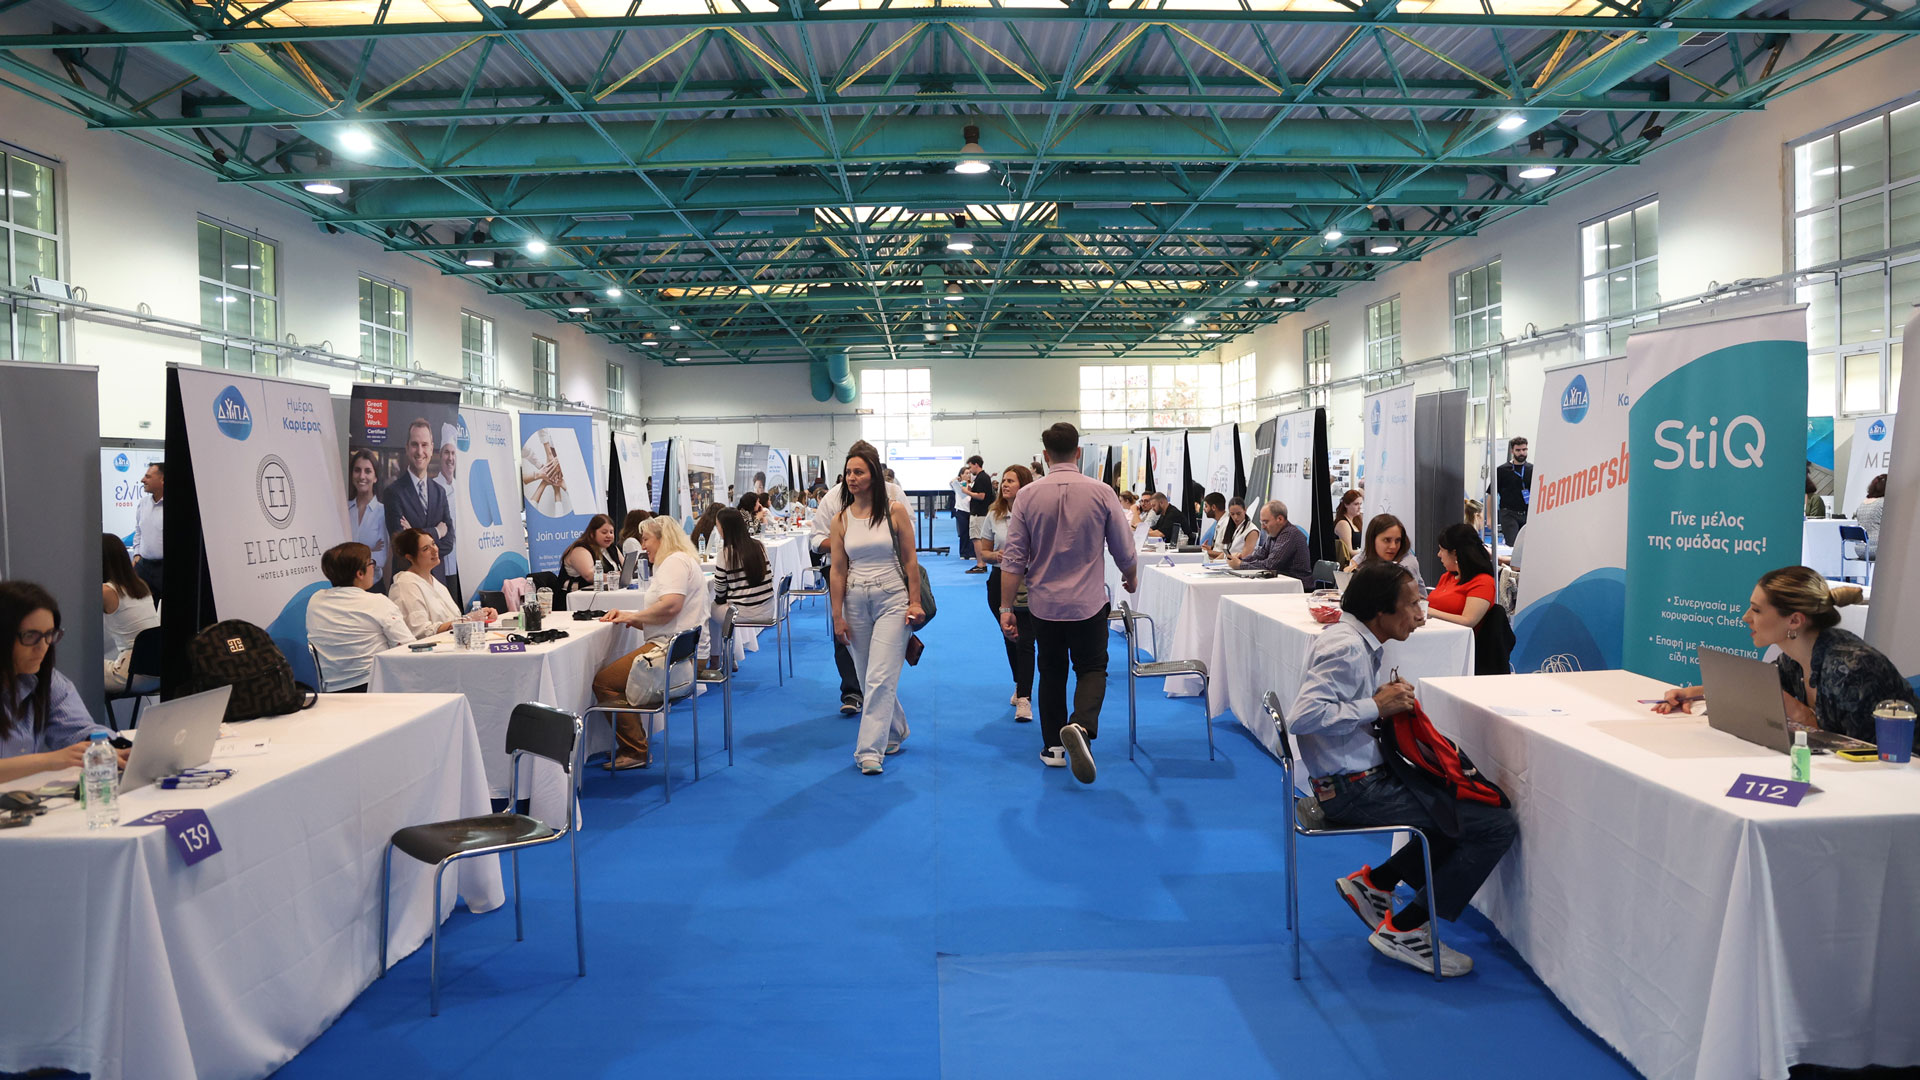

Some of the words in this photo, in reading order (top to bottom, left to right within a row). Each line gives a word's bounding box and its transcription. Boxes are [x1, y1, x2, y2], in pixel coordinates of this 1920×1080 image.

[286, 396, 314, 415] Ημέρα
[1563, 387, 1588, 407] ΔΥΠΑ
[282, 416, 322, 434] Καριέρας
[1653, 415, 1766, 470] StiQ
[1670, 510, 1697, 526] Γίνε
[1701, 511, 1745, 531] μέλος
[478, 531, 504, 550] affidea
[536, 531, 554, 542] Join
[555, 530, 570, 540] our
[1647, 535, 1672, 550] της
[1675, 533, 1730, 553] ομάδας
[1733, 537, 1767, 555] μας!
[244, 535, 321, 566] ELECTRA
[260, 570, 284, 580] HOTELS
[290, 565, 315, 575] RESORTS
[1673, 596, 1727, 611] Συνεργασία
[1729, 603, 1741, 613] με
[1661, 609, 1714, 625] κορυφαίους
[1716, 615, 1746, 628] Chefs.
[1655, 634, 1684, 650] Επαφή
[1685, 641, 1697, 650] με
[1669, 651, 1687, 663] είδη
[1745, 781, 1788, 799] 112
[178, 823, 210, 853] 139
